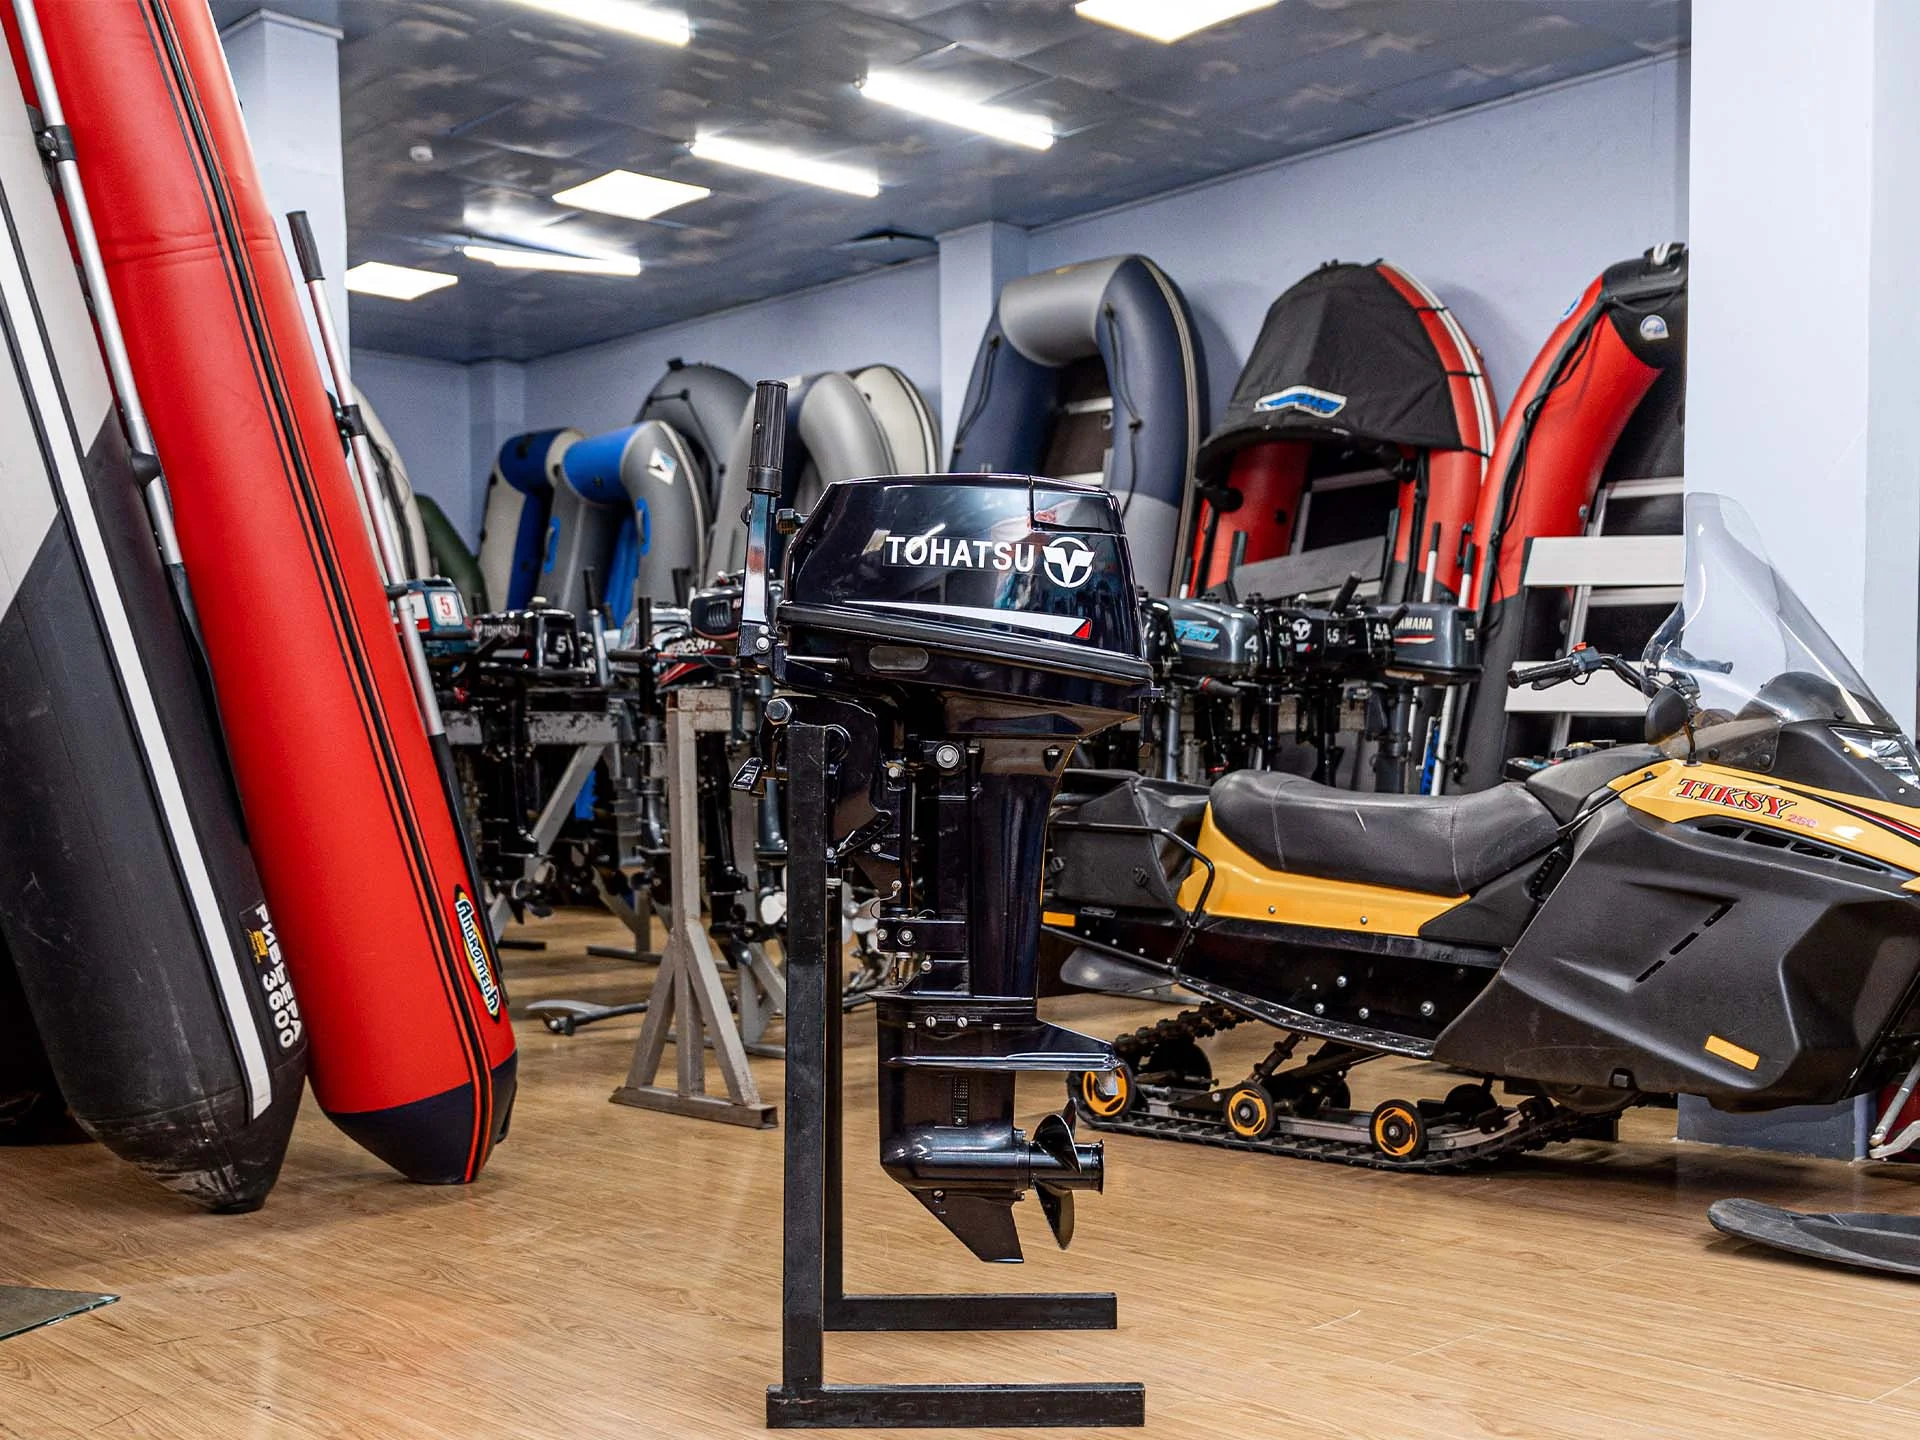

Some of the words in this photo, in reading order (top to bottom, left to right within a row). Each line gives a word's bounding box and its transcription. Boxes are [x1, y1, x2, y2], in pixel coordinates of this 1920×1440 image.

[885, 535, 1035, 573] TOHATSU
[440, 596, 451, 616] 5
[1395, 617, 1433, 630] AMAHA
[555, 635, 567, 653] 5
[1159, 631, 1168, 646] 3
[1244, 635, 1258, 652] 4
[1464, 628, 1475, 641] 5
[1676, 778, 1798, 819] TIKSY
[255, 903, 302, 1042] РИВЬЕРА
[262, 970, 296, 1049] 3600
